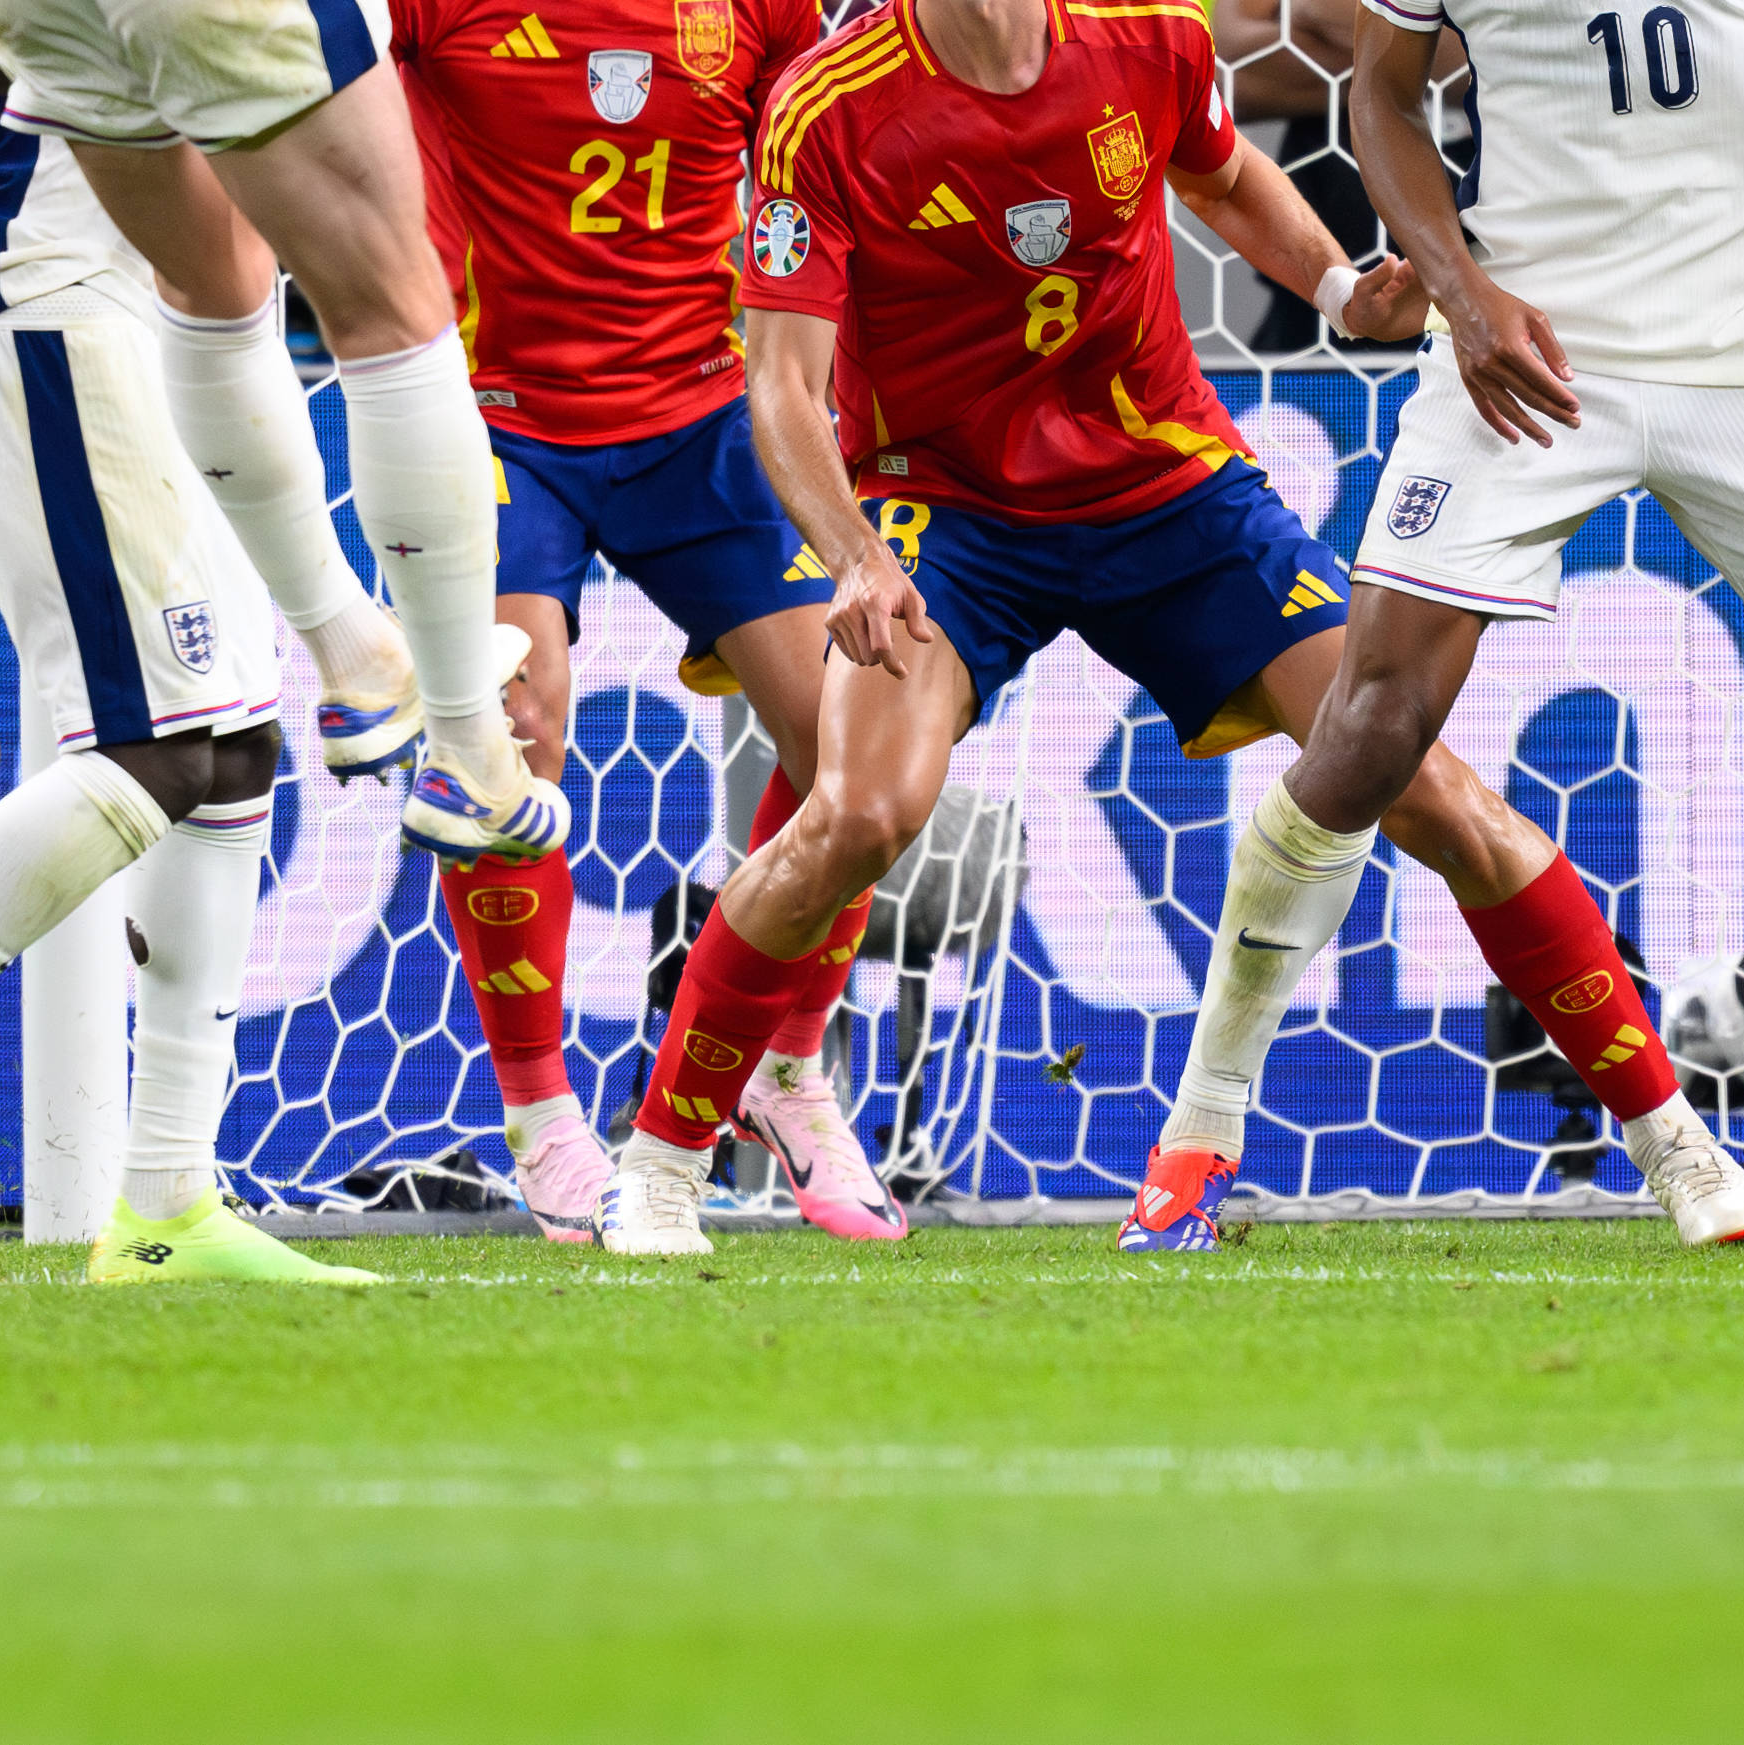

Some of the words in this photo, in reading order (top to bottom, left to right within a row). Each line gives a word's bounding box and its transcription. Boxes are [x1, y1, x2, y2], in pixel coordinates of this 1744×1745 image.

[1587, 5, 1700, 116] 10
[568, 138, 672, 235] 21
[1024, 273, 1080, 357] 8
